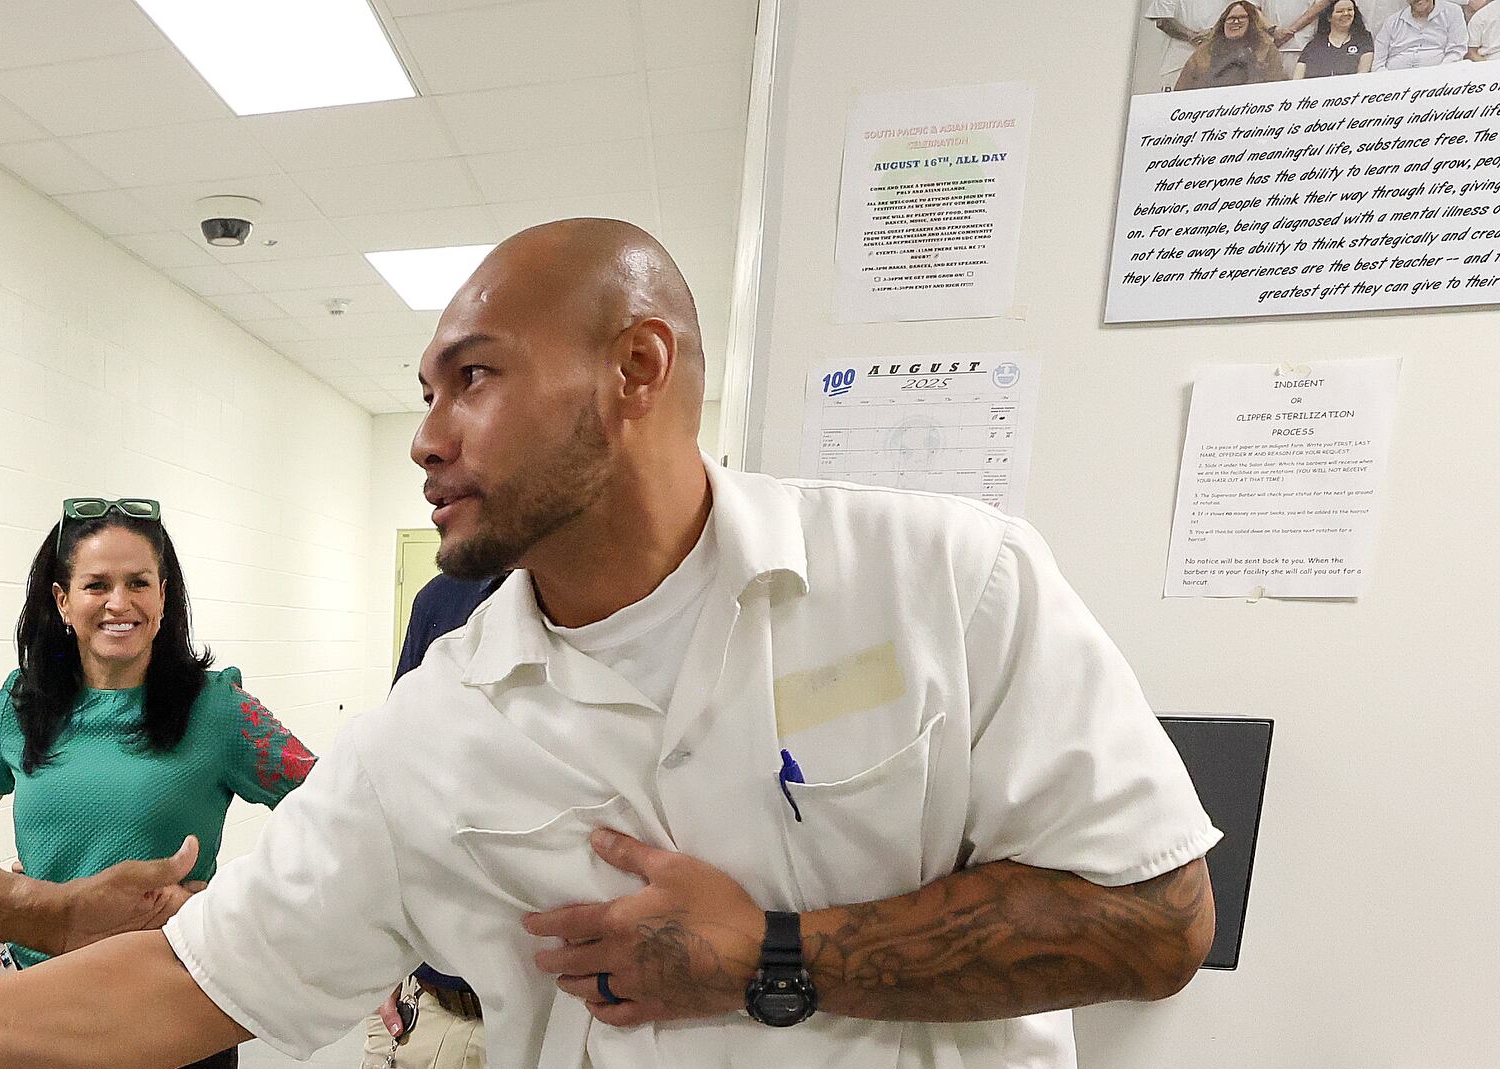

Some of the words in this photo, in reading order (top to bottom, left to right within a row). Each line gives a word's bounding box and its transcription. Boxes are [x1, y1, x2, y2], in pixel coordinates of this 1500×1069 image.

[1170, 102, 1275, 124] Congratulations
[1278, 98, 1292, 112] to
[1296, 96, 1319, 110] the
[1321, 92, 1361, 108] most
[1360, 87, 1411, 104] recent
[1410, 81, 1486, 104] graduates
[1489, 82, 1500, 92] o
[864, 131, 896, 140] SOUTH
[896, 125, 928, 138] PACIFIC
[939, 122, 969, 133] ASIAN
[970, 118, 1016, 131] HERITAGE
[1140, 131, 1198, 147] Training!
[1200, 128, 1228, 142] This
[1231, 125, 1285, 140] training
[1287, 123, 1301, 135] is
[1304, 117, 1346, 133] about
[1346, 114, 1404, 129] learning
[1406, 106, 1480, 124] individual
[874, 160, 921, 171] AUGUST
[955, 155, 979, 165] ALL
[981, 153, 1007, 163] DAY
[1145, 153, 1217, 173] productive
[1219, 149, 1248, 164] and
[1246, 144, 1325, 162] meaningful
[1325, 141, 1353, 156] life,
[1356, 136, 1430, 153] substance
[1434, 132, 1468, 146] free.
[1473, 128, 1499, 143] The
[1154, 178, 1184, 192] that
[1184, 177, 1243, 191] everyone
[1246, 171, 1271, 185] has
[1274, 169, 1297, 183] the
[1299, 165, 1344, 182] ability
[1346, 164, 1361, 177] to
[1364, 164, 1400, 176] learn
[1403, 157, 1434, 173] and
[1431, 158, 1471, 174] grow,
[1472, 156, 1500, 170] peo
[1133, 202, 1189, 216] behavior,
[1193, 197, 1221, 212] and
[1217, 196, 1262, 213] people
[1265, 192, 1300, 207] think
[1303, 190, 1338, 204] their
[1340, 191, 1369, 204] way
[1371, 182, 1425, 200] through
[1428, 181, 1456, 195] life,
[1127, 230, 1145, 239] on.
[1149, 225, 1173, 238] For
[1174, 222, 1229, 237] example,
[1233, 219, 1270, 235] being
[1272, 211, 1344, 232] diagnosed
[1343, 210, 1375, 225] with
[1377, 213, 1388, 222] a
[1389, 206, 1442, 222] mental
[1441, 205, 1490, 218] illness
[1130, 248, 1155, 261] not
[1156, 247, 1184, 260] take
[1187, 248, 1221, 260] away
[1223, 242, 1245, 256] the
[1248, 240, 1291, 256] ability
[1293, 239, 1308, 251] to
[1311, 236, 1346, 250] think
[1348, 231, 1440, 249] strategically
[1441, 226, 1472, 242] and
[1122, 271, 1151, 287] they
[1152, 271, 1185, 283] learn
[1188, 267, 1219, 281] that
[1218, 265, 1298, 281] experiences
[1301, 264, 1325, 274] are
[1328, 259, 1351, 273] the
[1353, 257, 1388, 271] best
[1389, 253, 1444, 269] teacher
[1463, 249, 1494, 264] and
[1258, 284, 1321, 303] greatest
[1319, 282, 1350, 300] gift
[1351, 281, 1383, 297] they
[1384, 283, 1409, 293] can
[1411, 279, 1442, 295] give
[1446, 276, 1461, 289] to
[1465, 274, 1500, 288] their
[822, 369, 856, 393] 100
[868, 361, 981, 376] AUGUST
[901, 378, 953, 390] 2025
[1274, 379, 1325, 389] INDIGENT
[1236, 413, 1272, 422] CLIPPER
[1275, 410, 1355, 421] STERILIZATION
[1271, 428, 1314, 436] PROCESS
[1243, 568, 1270, 576] facility
